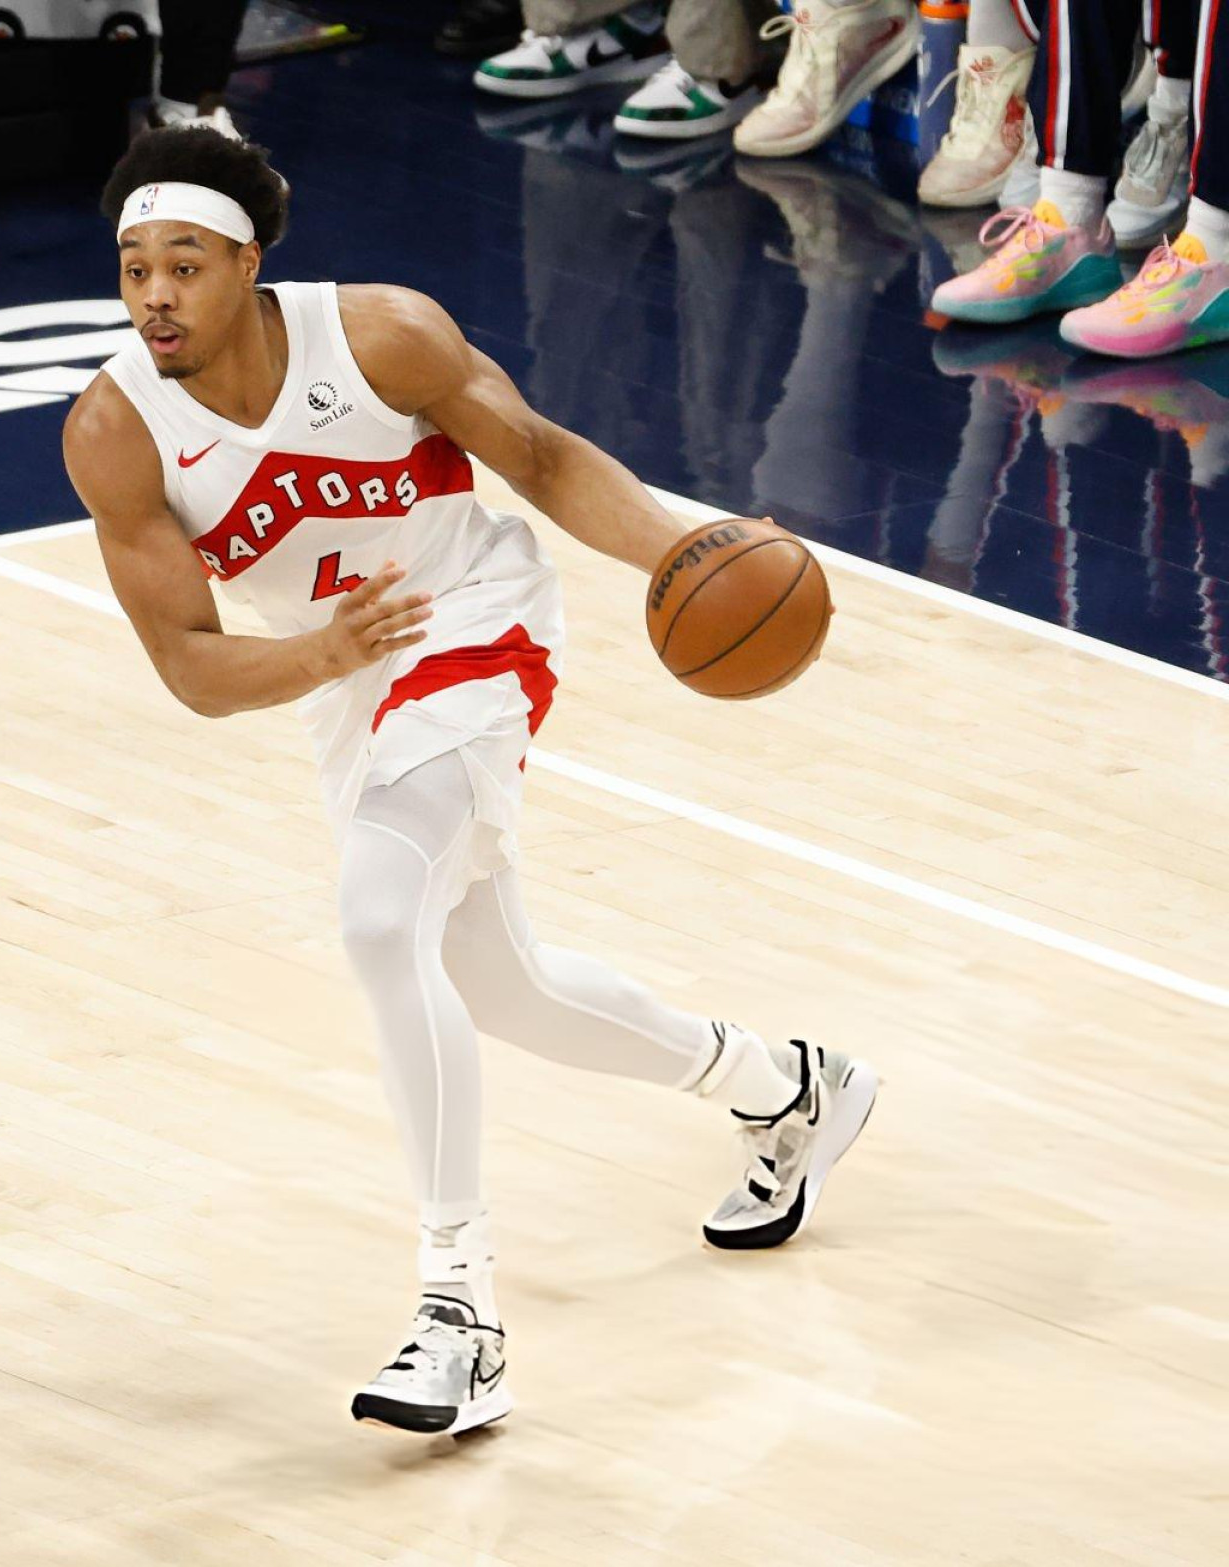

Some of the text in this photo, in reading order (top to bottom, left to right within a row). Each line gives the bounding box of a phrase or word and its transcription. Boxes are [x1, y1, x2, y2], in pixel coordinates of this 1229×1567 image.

[310, 403, 354, 431] Sun Life
[198, 470, 418, 575] RAPTORS
[310, 549, 369, 602] 4
[651, 524, 750, 612] Wilson
